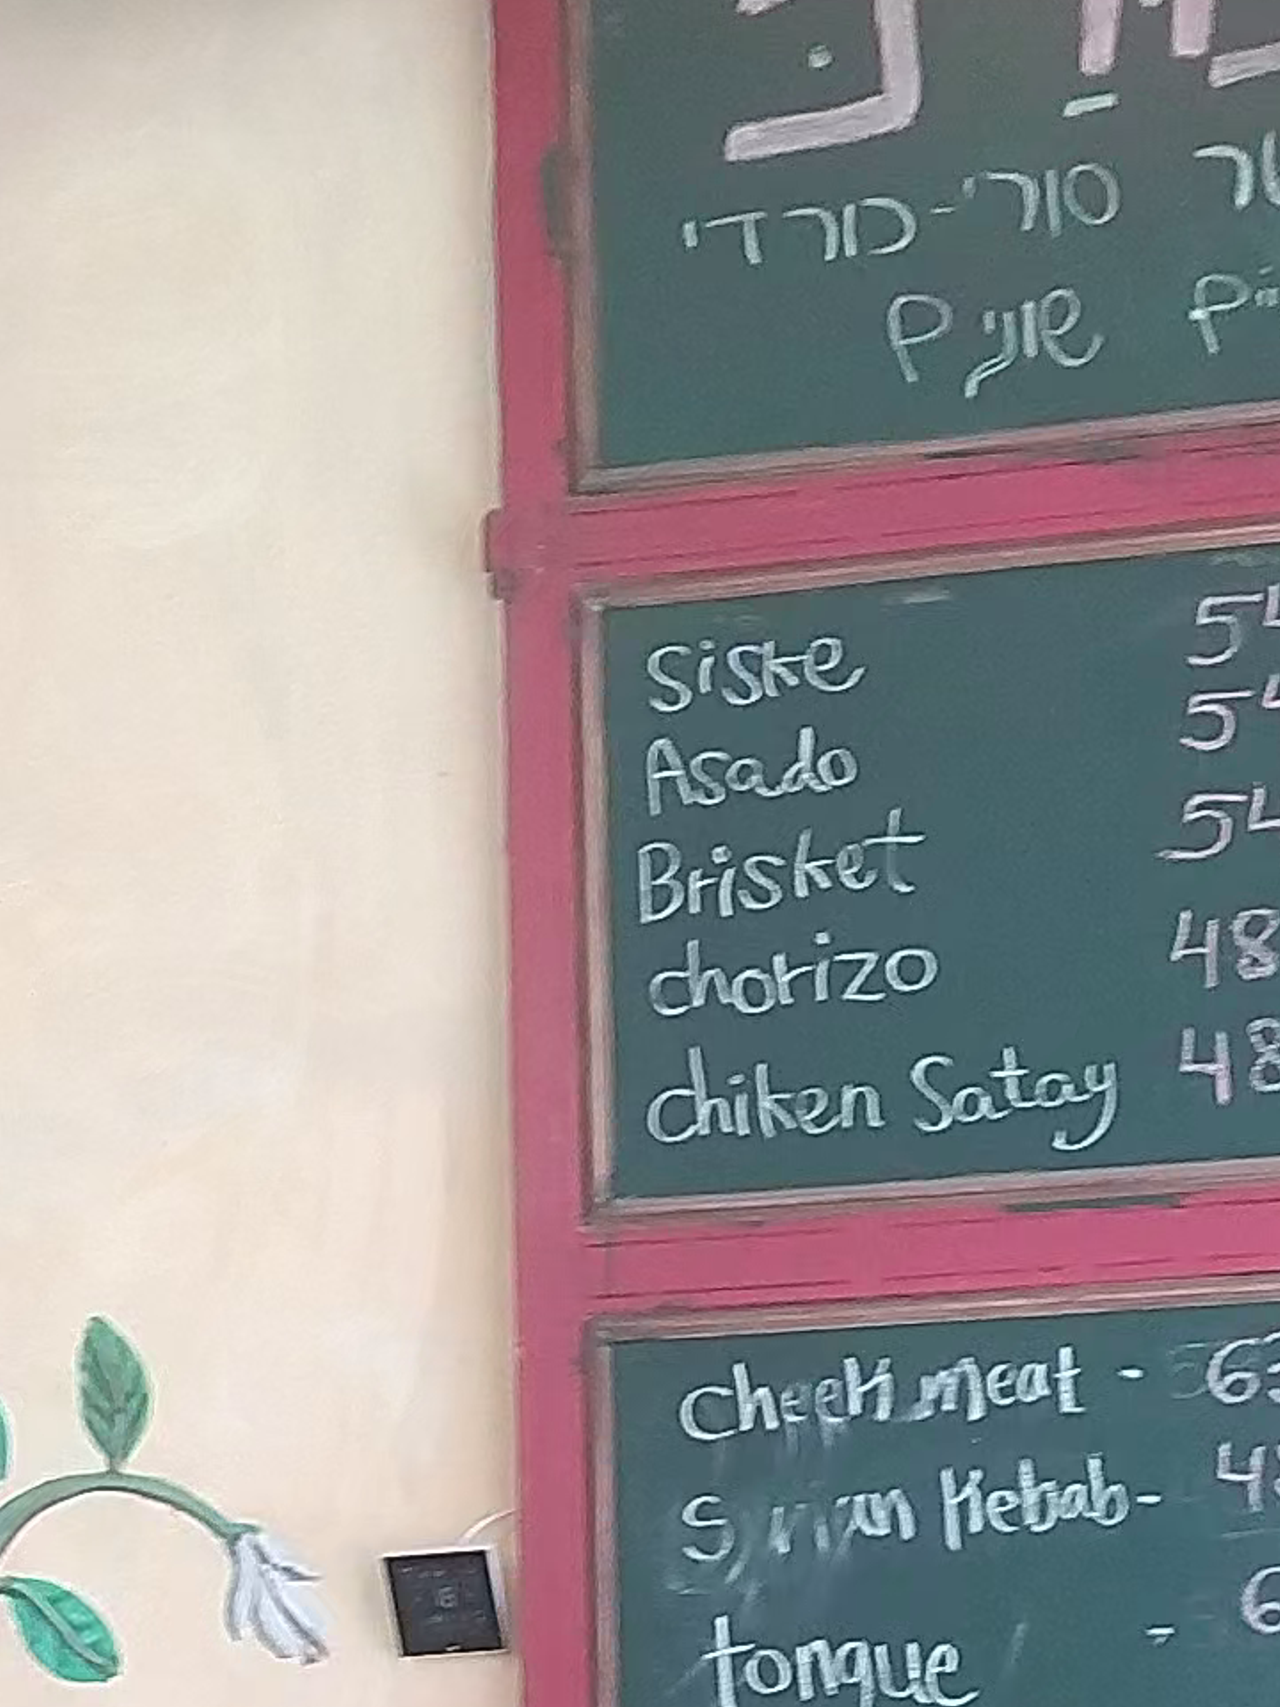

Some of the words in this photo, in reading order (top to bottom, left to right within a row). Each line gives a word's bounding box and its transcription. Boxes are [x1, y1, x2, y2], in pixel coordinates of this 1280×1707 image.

[886, 287, 1104, 398] שונים
[644, 636, 867, 713] Siske
[645, 725, 860, 816] Asado
[636, 806, 927, 925] Brisket
[647, 931, 940, 1017] chorizo
[908, 1046, 1119, 1151] Satay
[916, 1344, 1087, 1422] meat
[679, 1487, 918, 1583] Srian
